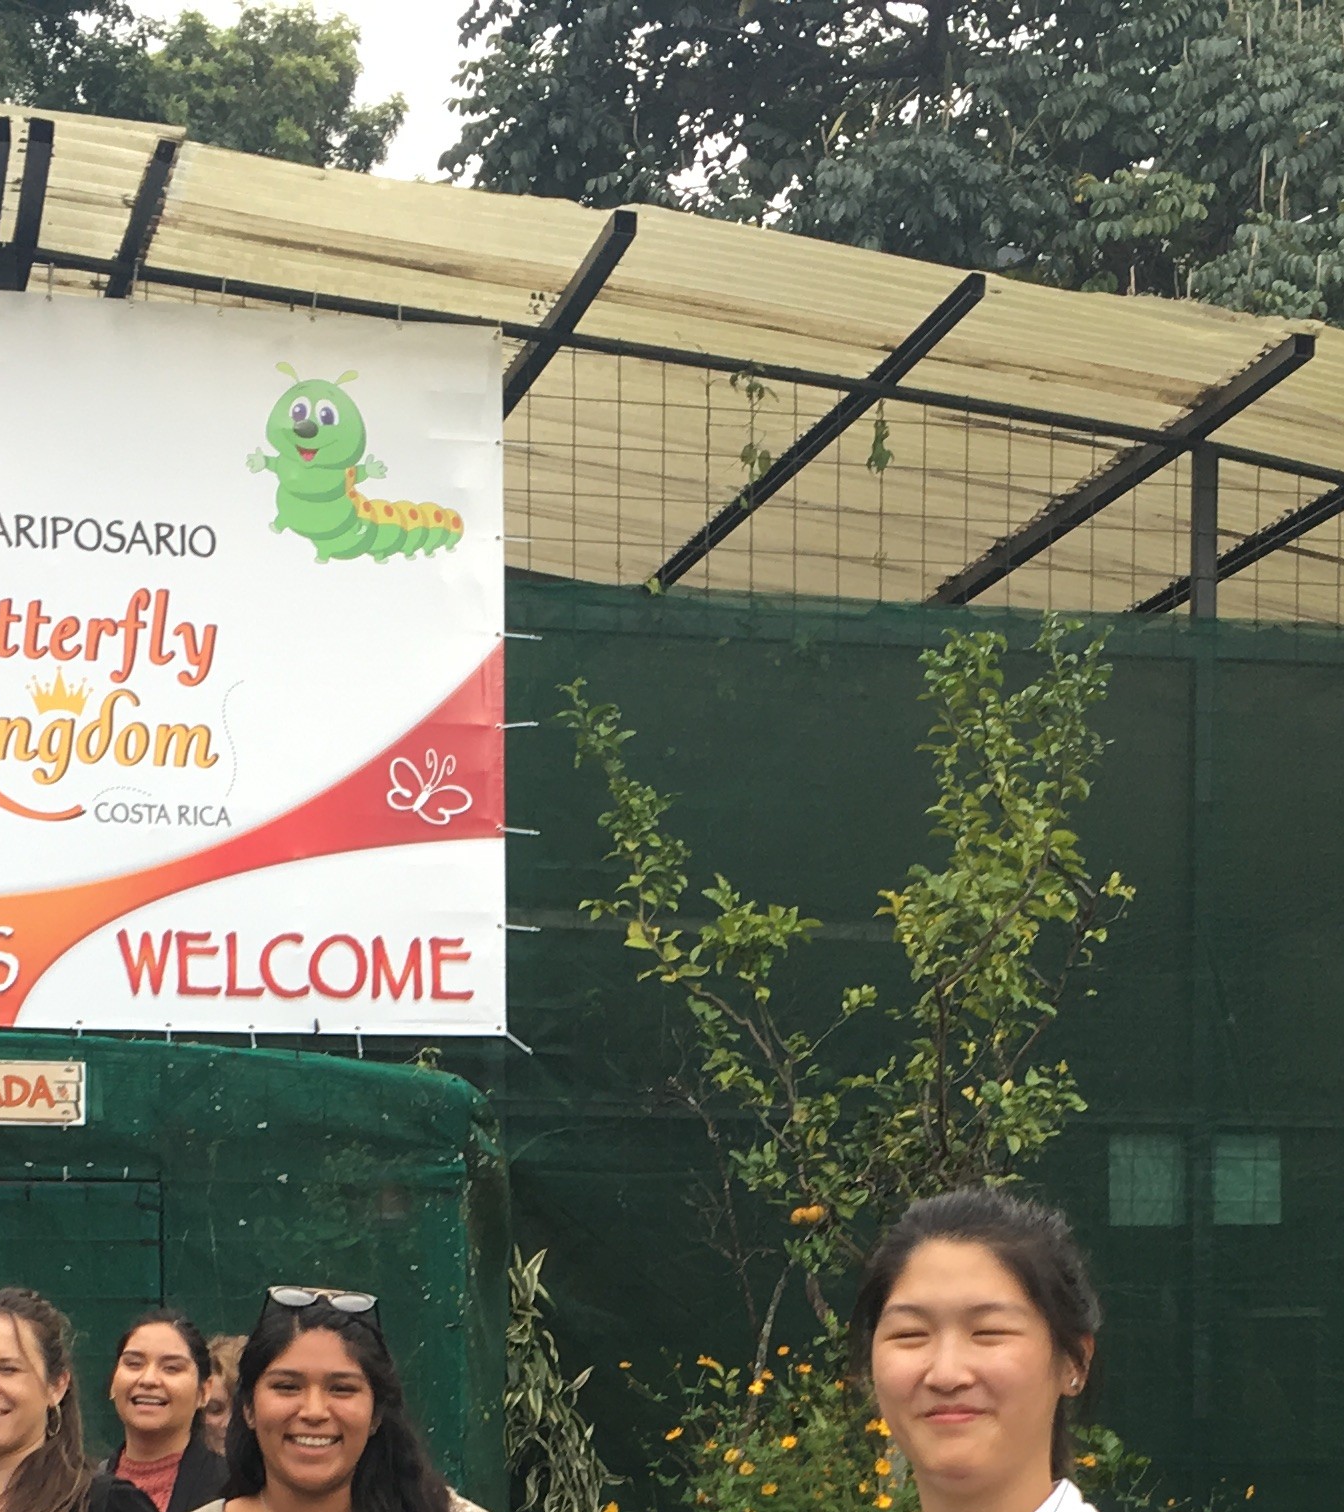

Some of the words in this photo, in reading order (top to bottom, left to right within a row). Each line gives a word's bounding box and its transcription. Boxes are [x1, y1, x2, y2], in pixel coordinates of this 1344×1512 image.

[93, 802, 172, 826] COSTA
[177, 805, 233, 828] RICA
[115, 928, 476, 1001] WELCOME
